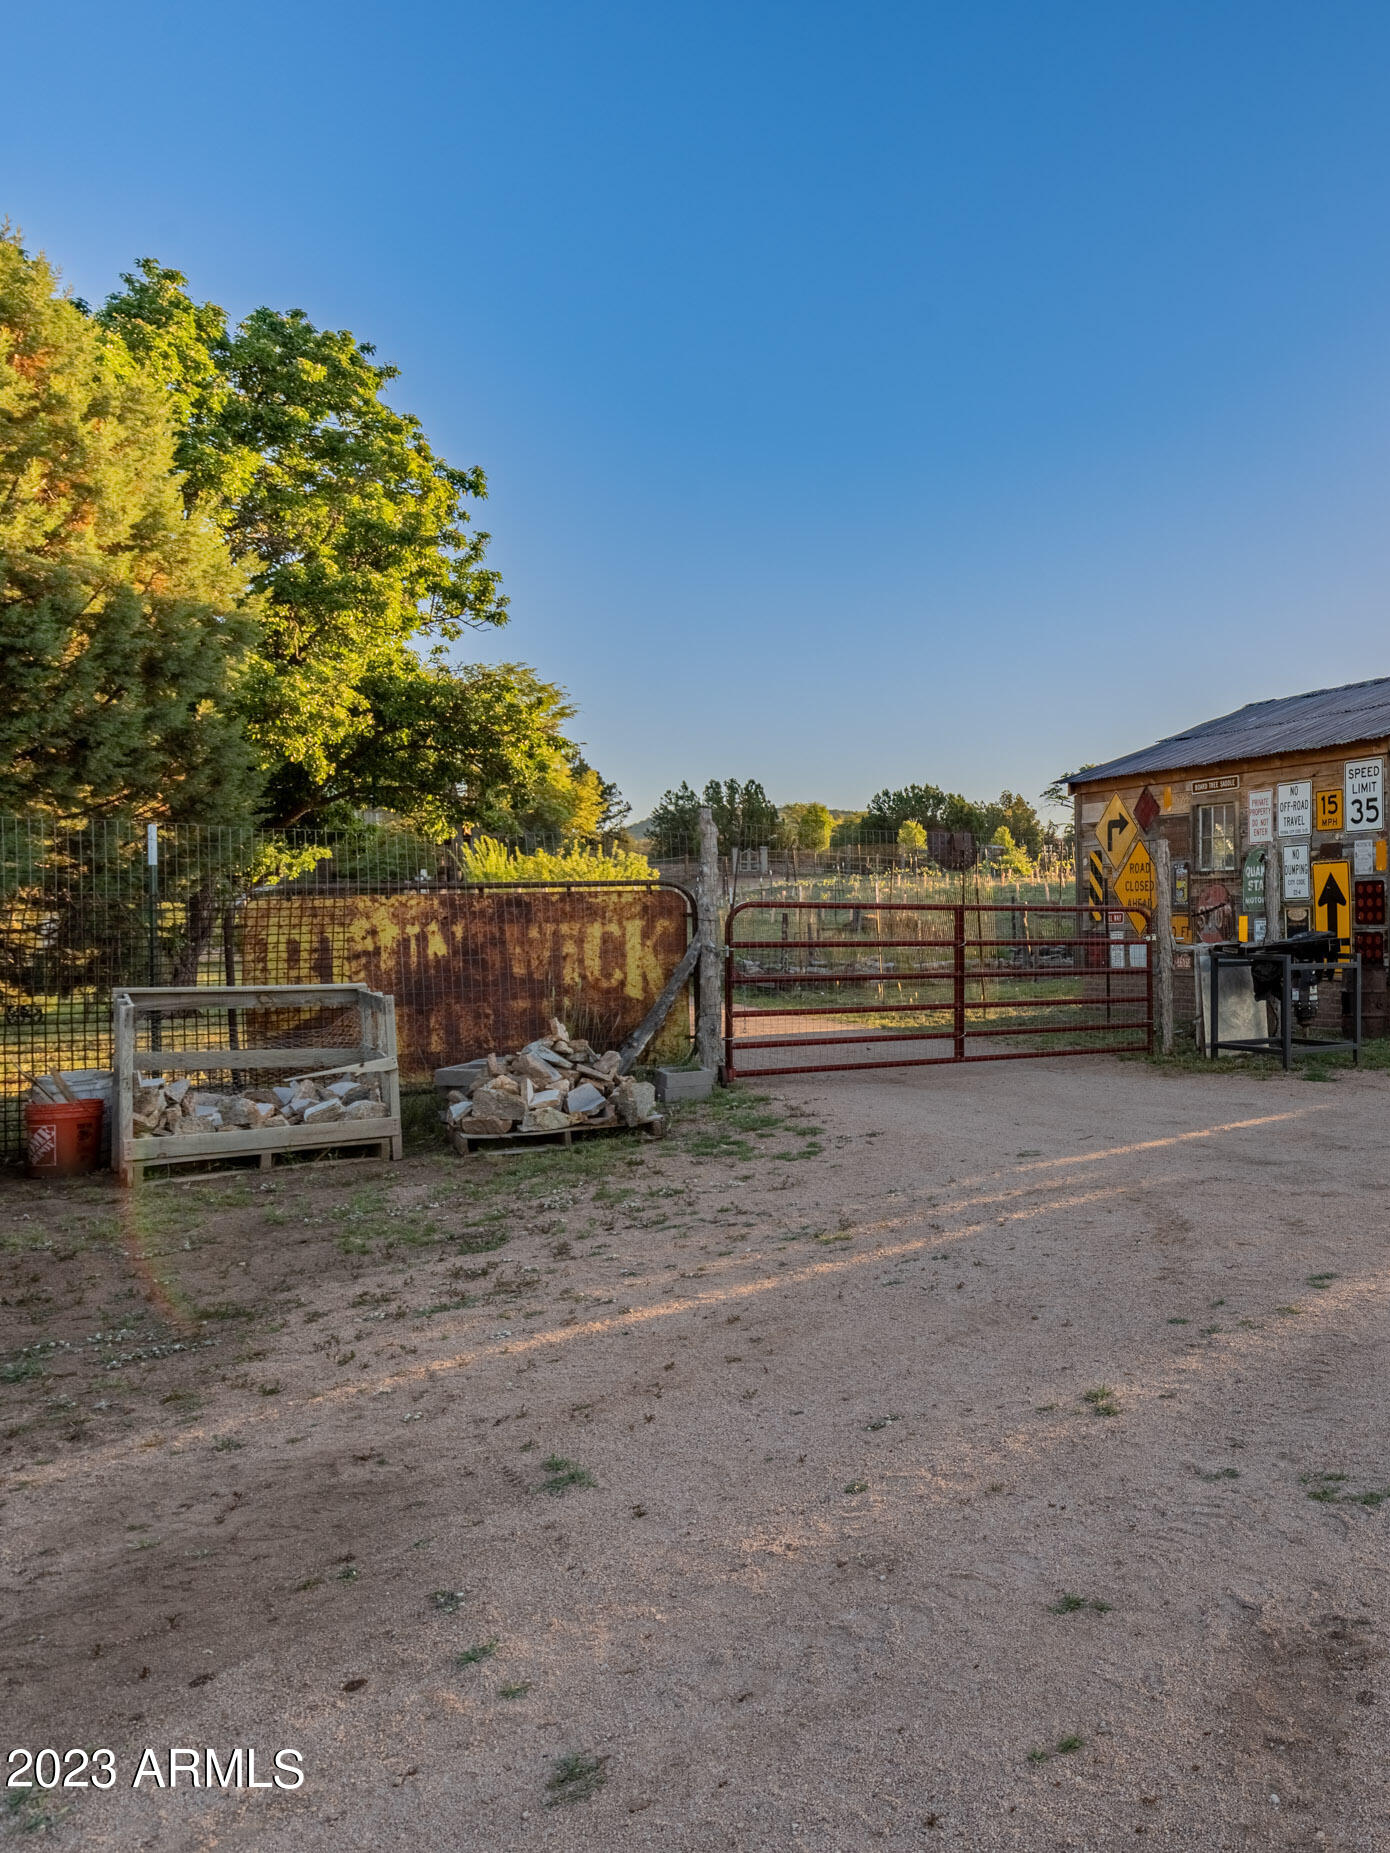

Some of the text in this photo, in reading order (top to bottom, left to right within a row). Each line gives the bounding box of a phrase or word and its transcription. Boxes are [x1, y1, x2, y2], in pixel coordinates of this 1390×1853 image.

[1348, 766, 1380, 780] SPEED
[1290, 785, 1298, 796] NO
[1352, 781, 1377, 794] LIMIT
[1252, 798, 1269, 808] PRIVATE
[1280, 799, 1309, 812] OFF-ROAD
[1321, 794, 1338, 815] 15
[1250, 807, 1271, 817] PROPERTY
[1350, 797, 1379, 824] 35
[1252, 817, 1269, 828] DO NOT
[1283, 815, 1305, 827] TRAVEL
[1322, 817, 1338, 826] MPH
[1253, 827, 1268, 837] ENTER
[1291, 848, 1300, 860] NO
[1130, 862, 1151, 874] ROAD
[1246, 865, 1265, 878] QUA
[1285, 863, 1308, 876] DUMPING
[1125, 880, 1155, 892] CLOSED
[1248, 879, 1265, 891] STA
